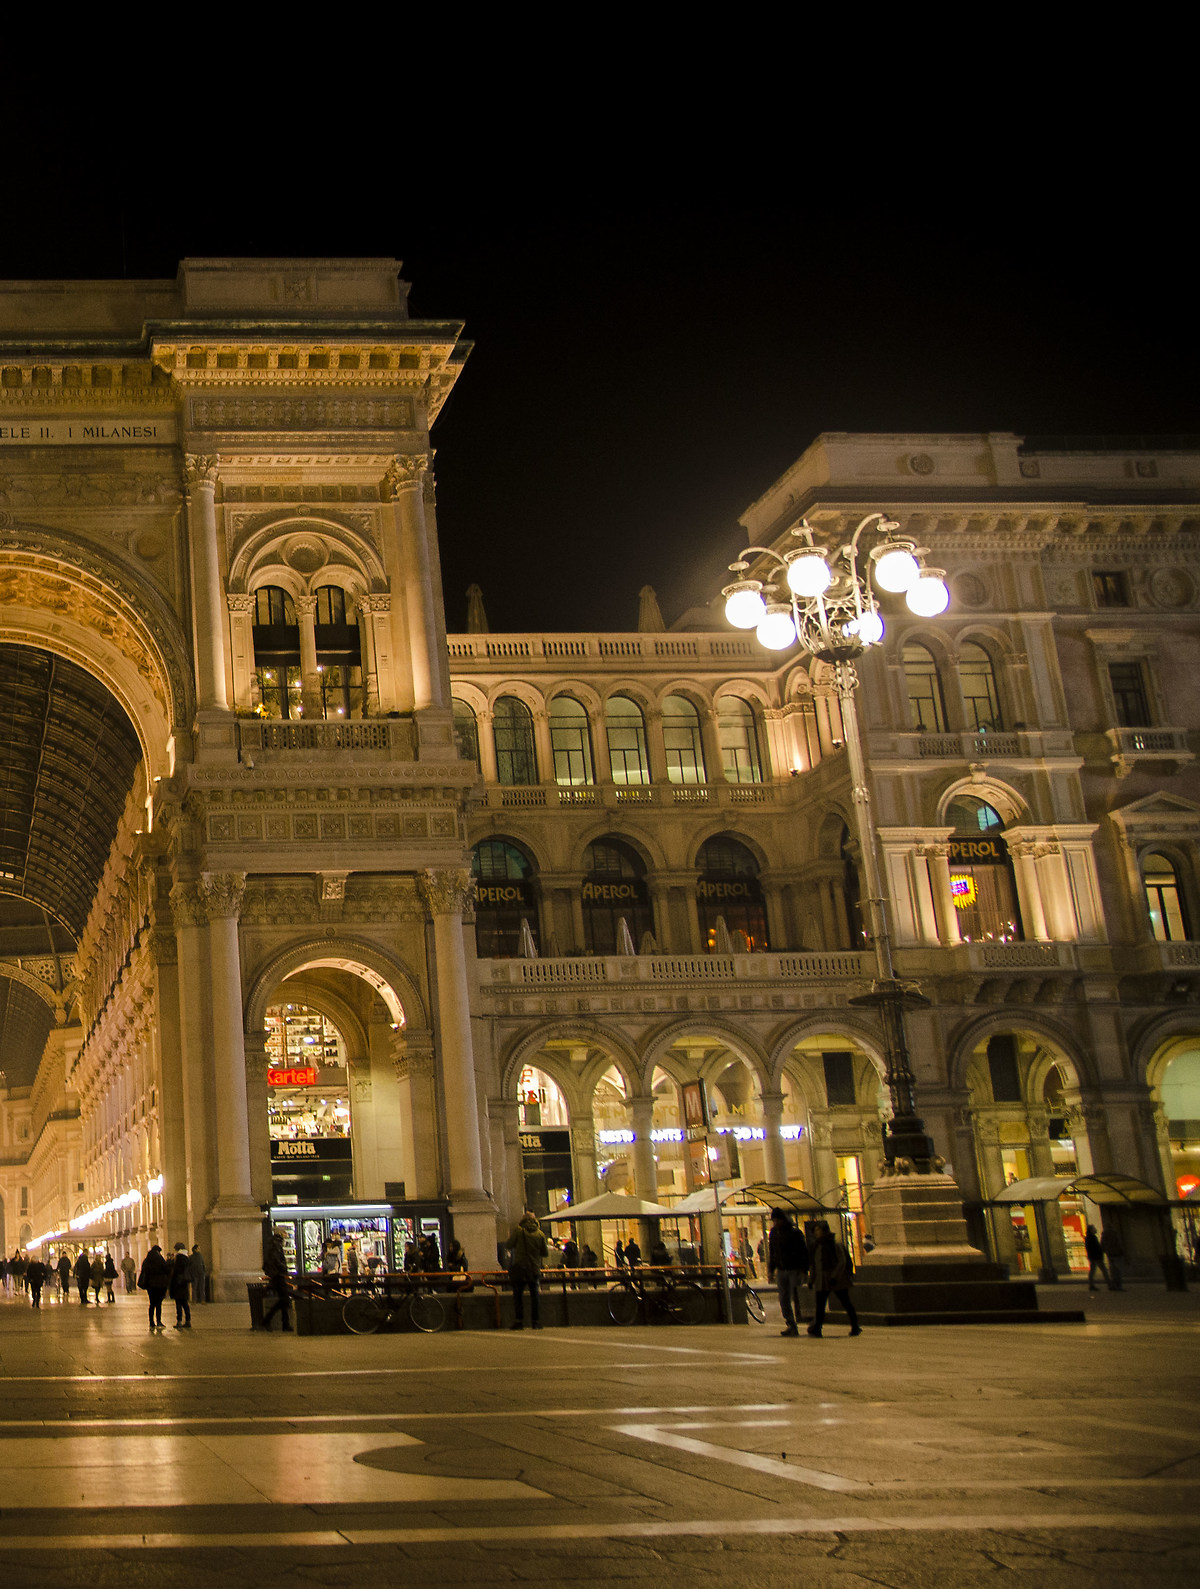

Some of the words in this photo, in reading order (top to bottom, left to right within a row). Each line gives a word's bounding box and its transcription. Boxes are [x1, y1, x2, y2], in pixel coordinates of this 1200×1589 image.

[68, 427, 73, 438] I
[82, 426, 157, 438] MILANESI
[951, 842, 1000, 857] PEROL
[583, 882, 638, 899] APEROL
[278, 1141, 316, 1155] Motta
